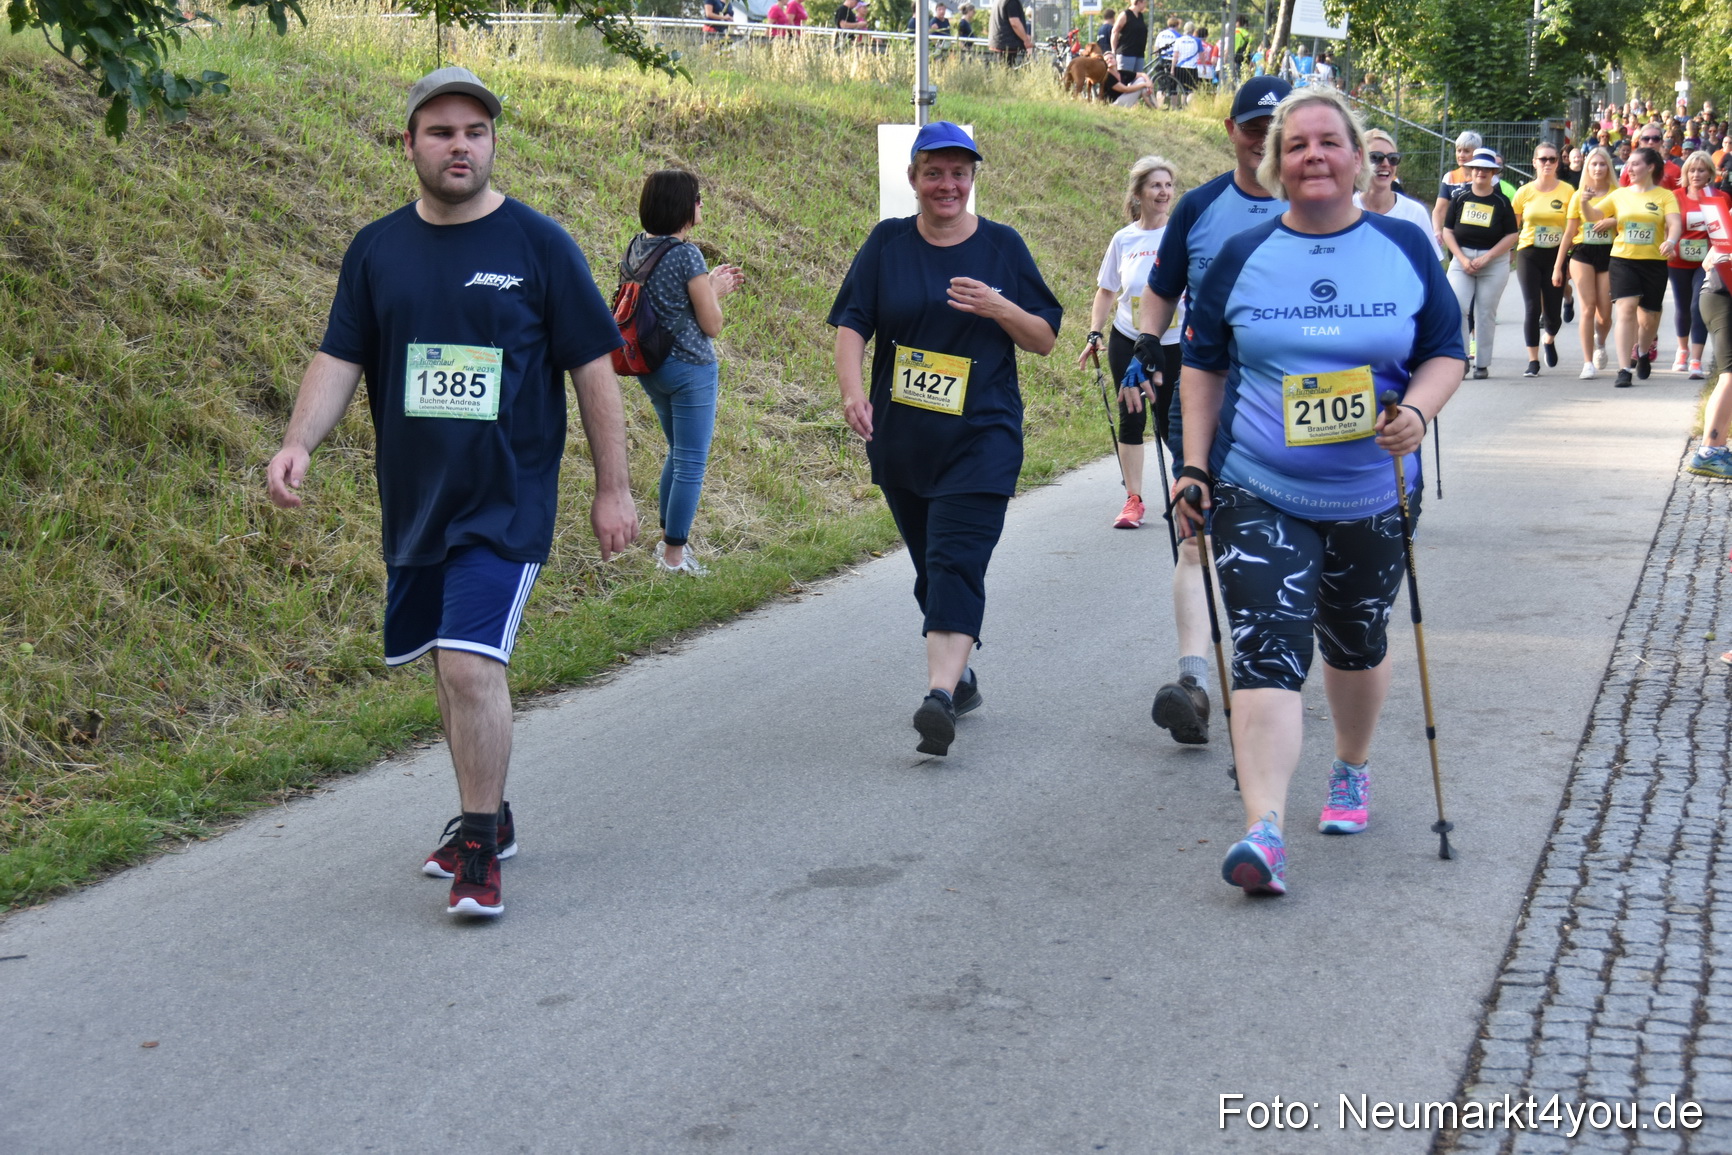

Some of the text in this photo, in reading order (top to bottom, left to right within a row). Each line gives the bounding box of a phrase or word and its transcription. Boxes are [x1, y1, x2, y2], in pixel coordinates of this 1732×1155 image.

[1466, 210, 1488, 220] 1966
[1537, 233, 1560, 242] 1765
[1628, 230, 1651, 239] 1762
[1684, 247, 1702, 256] 534
[1250, 302, 1397, 321] SCHABMÜLLER
[1301, 326, 1340, 336] TEAM
[417, 370, 487, 399] 1385
[902, 368, 957, 396] 1427
[419, 397, 481, 406] Buchner Andreas
[927, 394, 951, 403] Manuela
[1294, 393, 1365, 425] 2105
[1307, 421, 1357, 433] Brauner Petra
[1248, 476, 1397, 508] www.schabmueller.de
